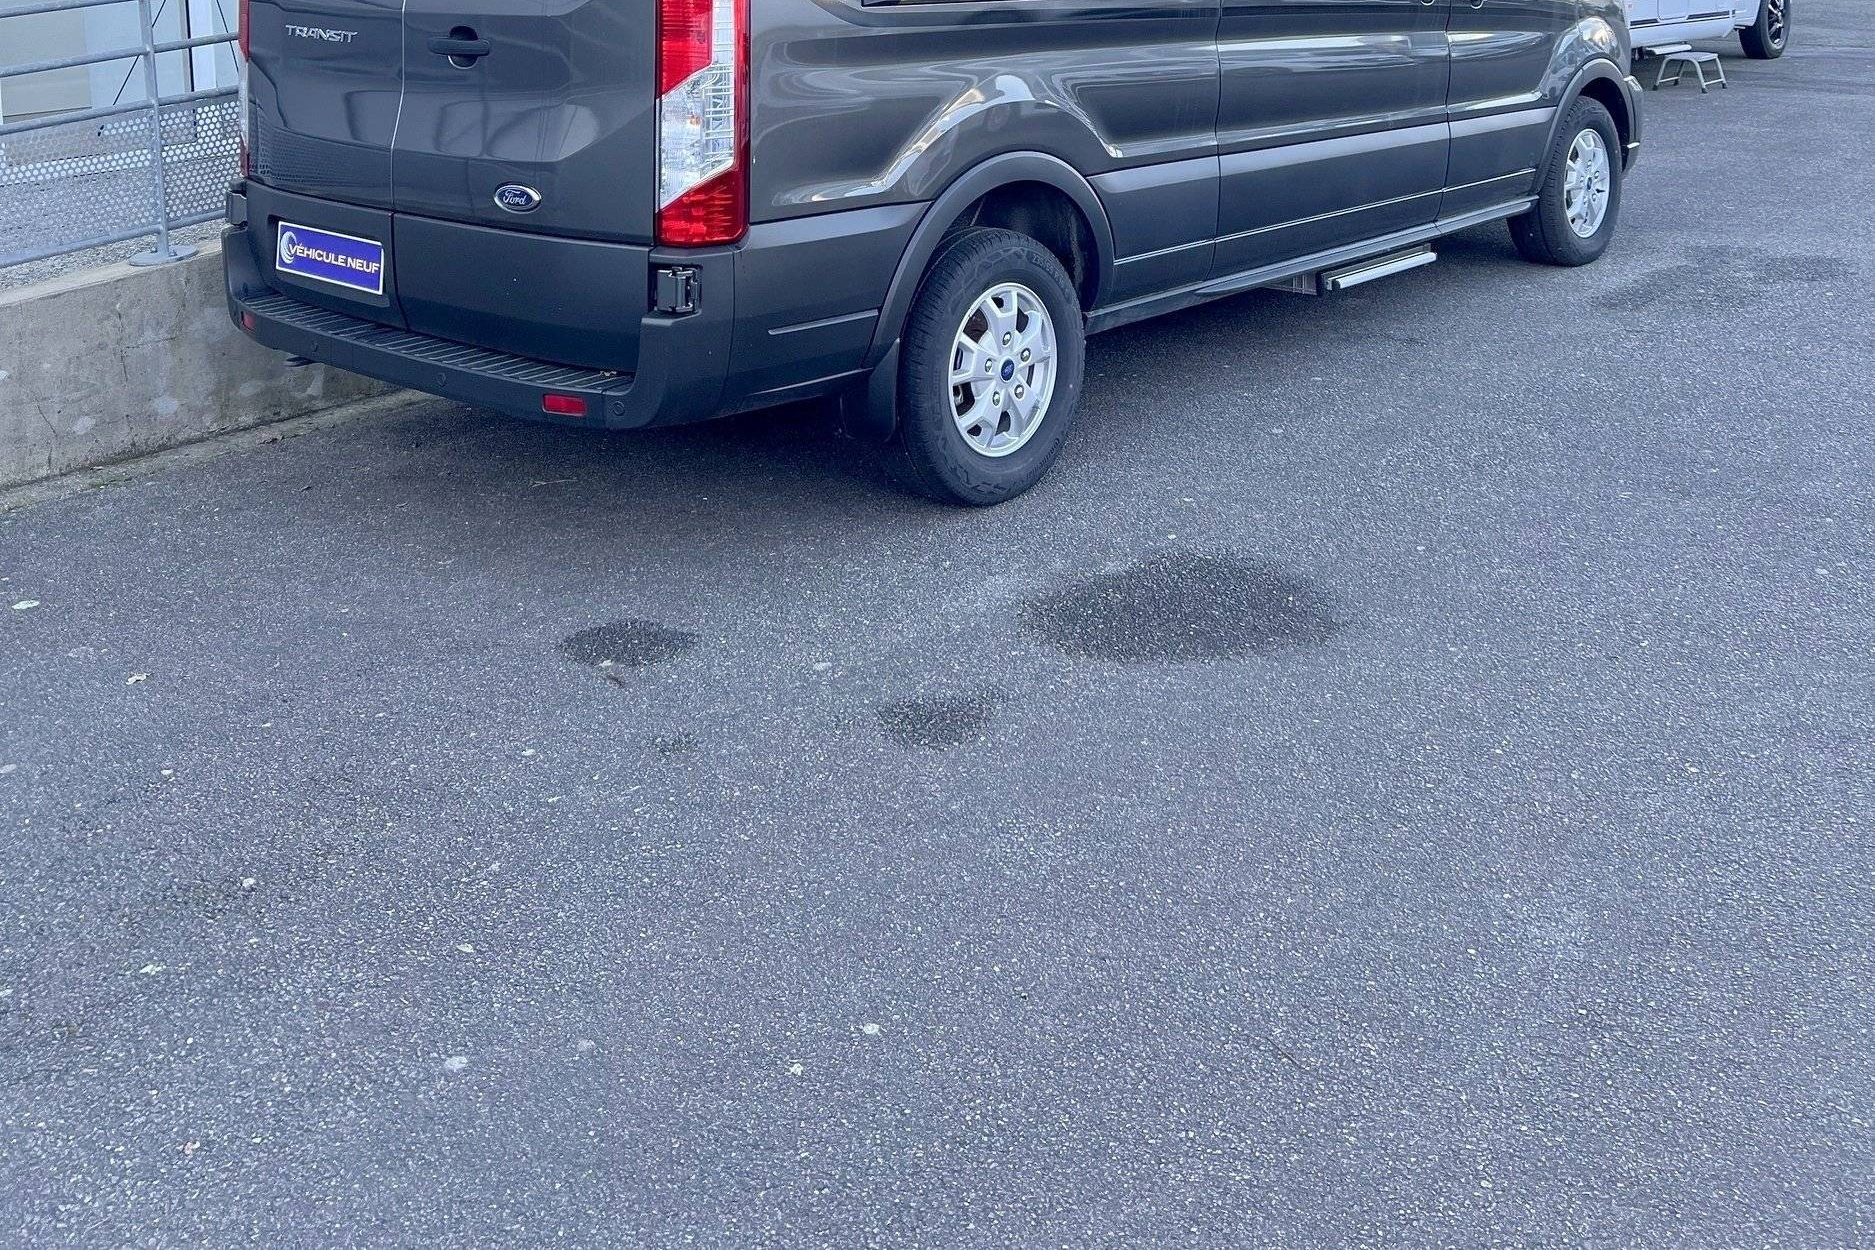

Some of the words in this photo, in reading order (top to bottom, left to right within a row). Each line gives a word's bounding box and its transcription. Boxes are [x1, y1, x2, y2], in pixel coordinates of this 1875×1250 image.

[285, 24, 358, 43] TRANSIT
[502, 189, 527, 205] Ford
[288, 241, 348, 267] VÉHICULE
[346, 258, 380, 274] NEUF
